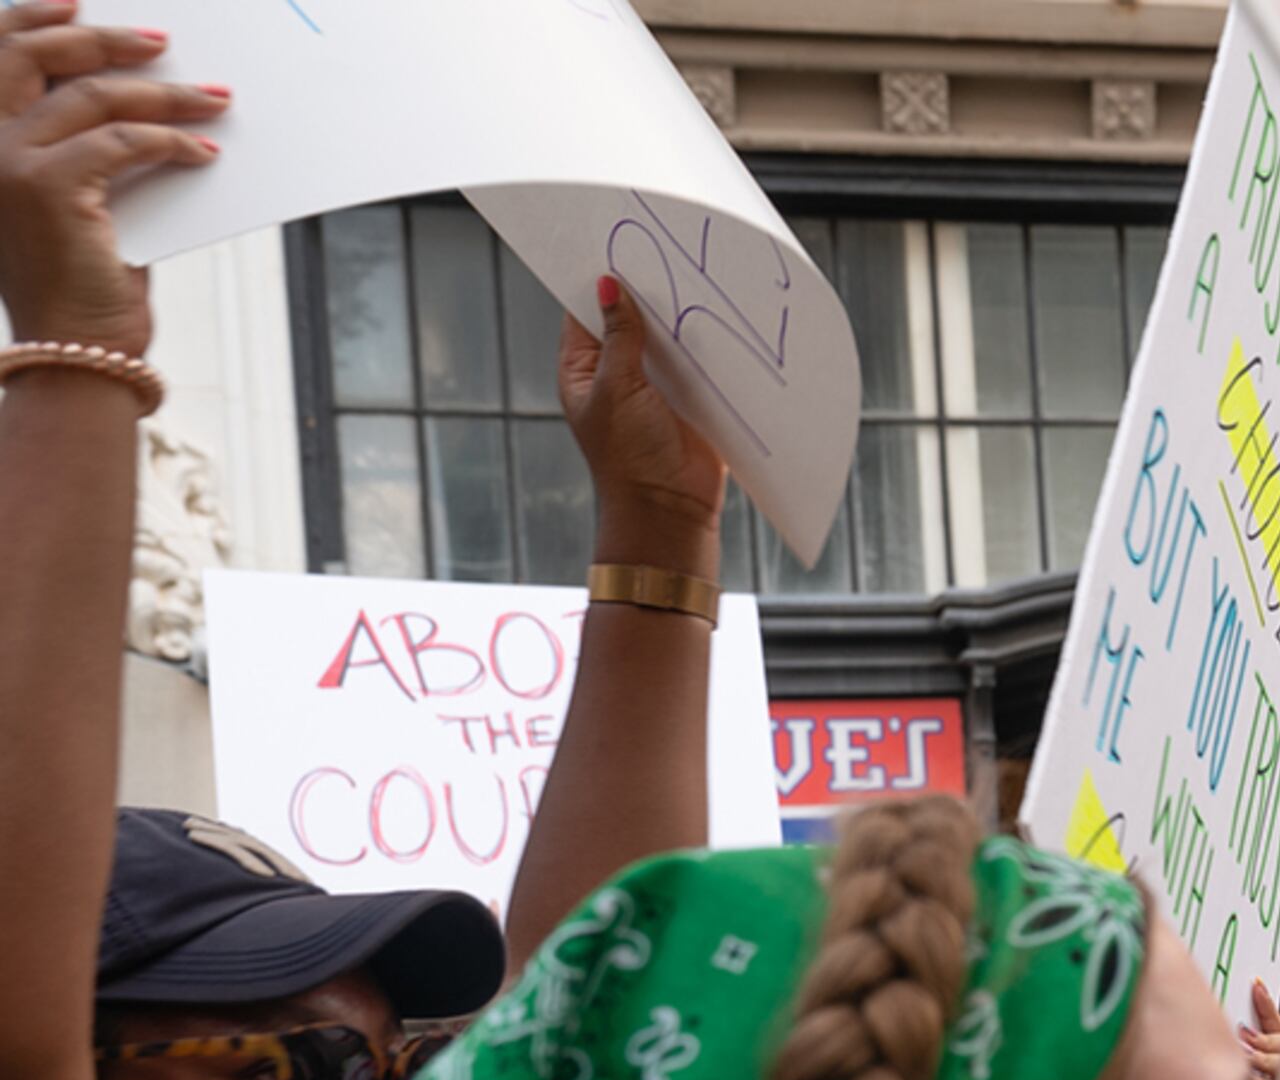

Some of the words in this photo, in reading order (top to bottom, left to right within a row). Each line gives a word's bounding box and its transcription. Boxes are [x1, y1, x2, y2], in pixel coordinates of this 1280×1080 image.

[1187, 232, 1222, 355] A
[317, 607, 588, 702] ABO
[1124, 407, 1207, 651] BUT
[1187, 557, 1251, 794] YOU
[436, 710, 560, 754] THE
[1081, 585, 1145, 764] ME
[1150, 735, 1214, 950] WITH
[1212, 912, 1238, 1004] A
